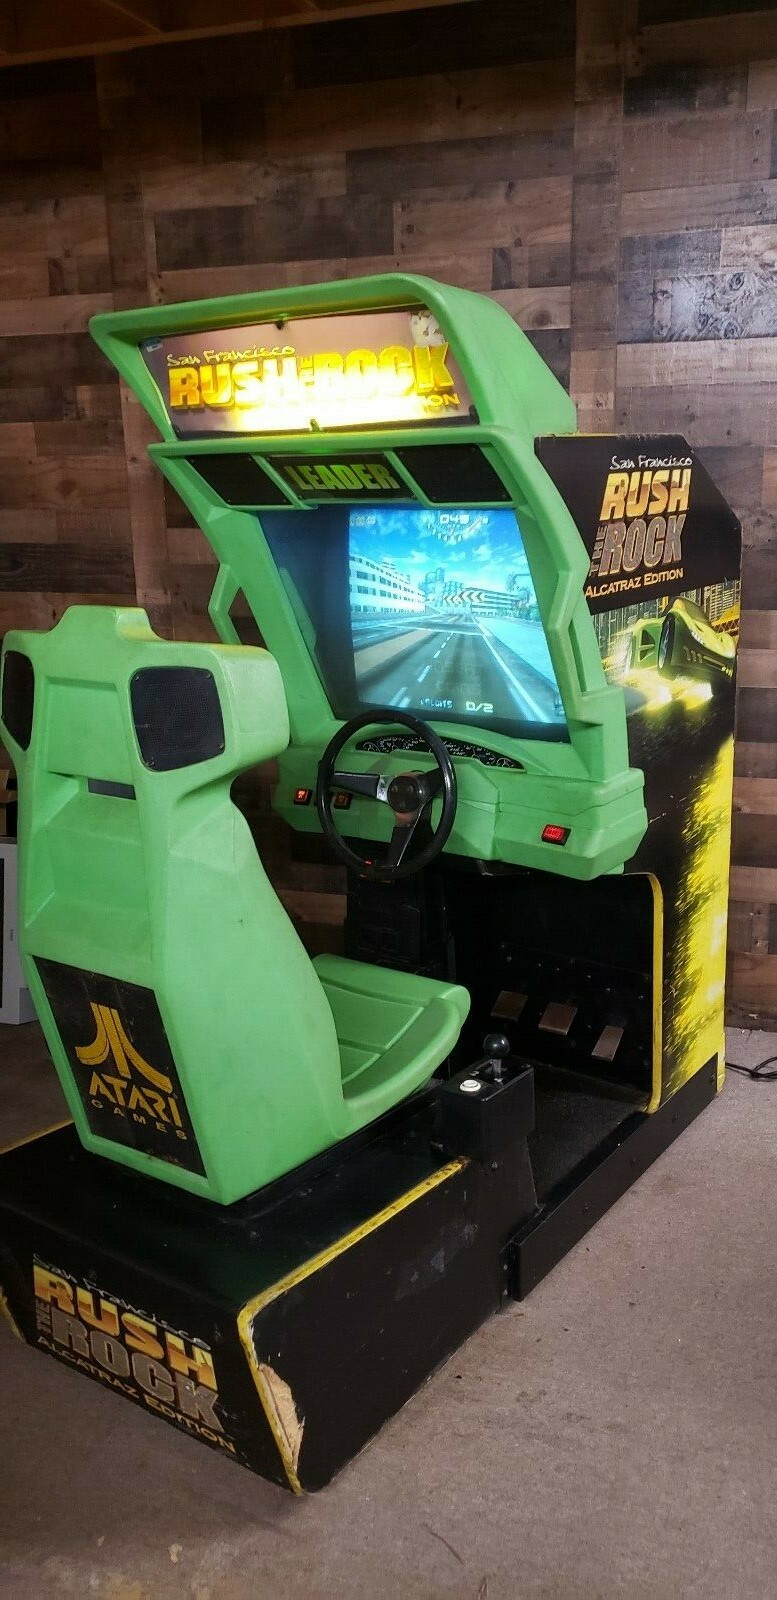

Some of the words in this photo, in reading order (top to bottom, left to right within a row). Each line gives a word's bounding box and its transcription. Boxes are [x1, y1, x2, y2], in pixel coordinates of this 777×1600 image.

[167, 353, 201, 366] San
[203, 345, 296, 363] Francisco
[168, 356, 299, 409] RUSH
[314, 343, 454, 397] ROCK
[284, 464, 401, 490] LEADER
[610, 455, 636, 470] San
[637, 454, 693, 469] Francisco
[600, 469, 692, 521] RUSH
[588, 524, 608, 579] THE
[598, 514, 687, 577] ROCK
[585, 577, 641, 598] ALCATRAZ
[644, 568, 684, 586] EDITION
[89, 1071, 182, 1128] ATARI
[91, 1099, 187, 1140] GAMES
[33, 1253, 78, 1284] San
[83, 1277, 211, 1351] Francisco
[33, 1264, 218, 1391] RUSH
[35, 1299, 52, 1333] THE
[51, 1307, 225, 1433] ROCK
[37, 1336, 140, 1399] ALCATRAZ
[144, 1394, 237, 1453] EDITION
